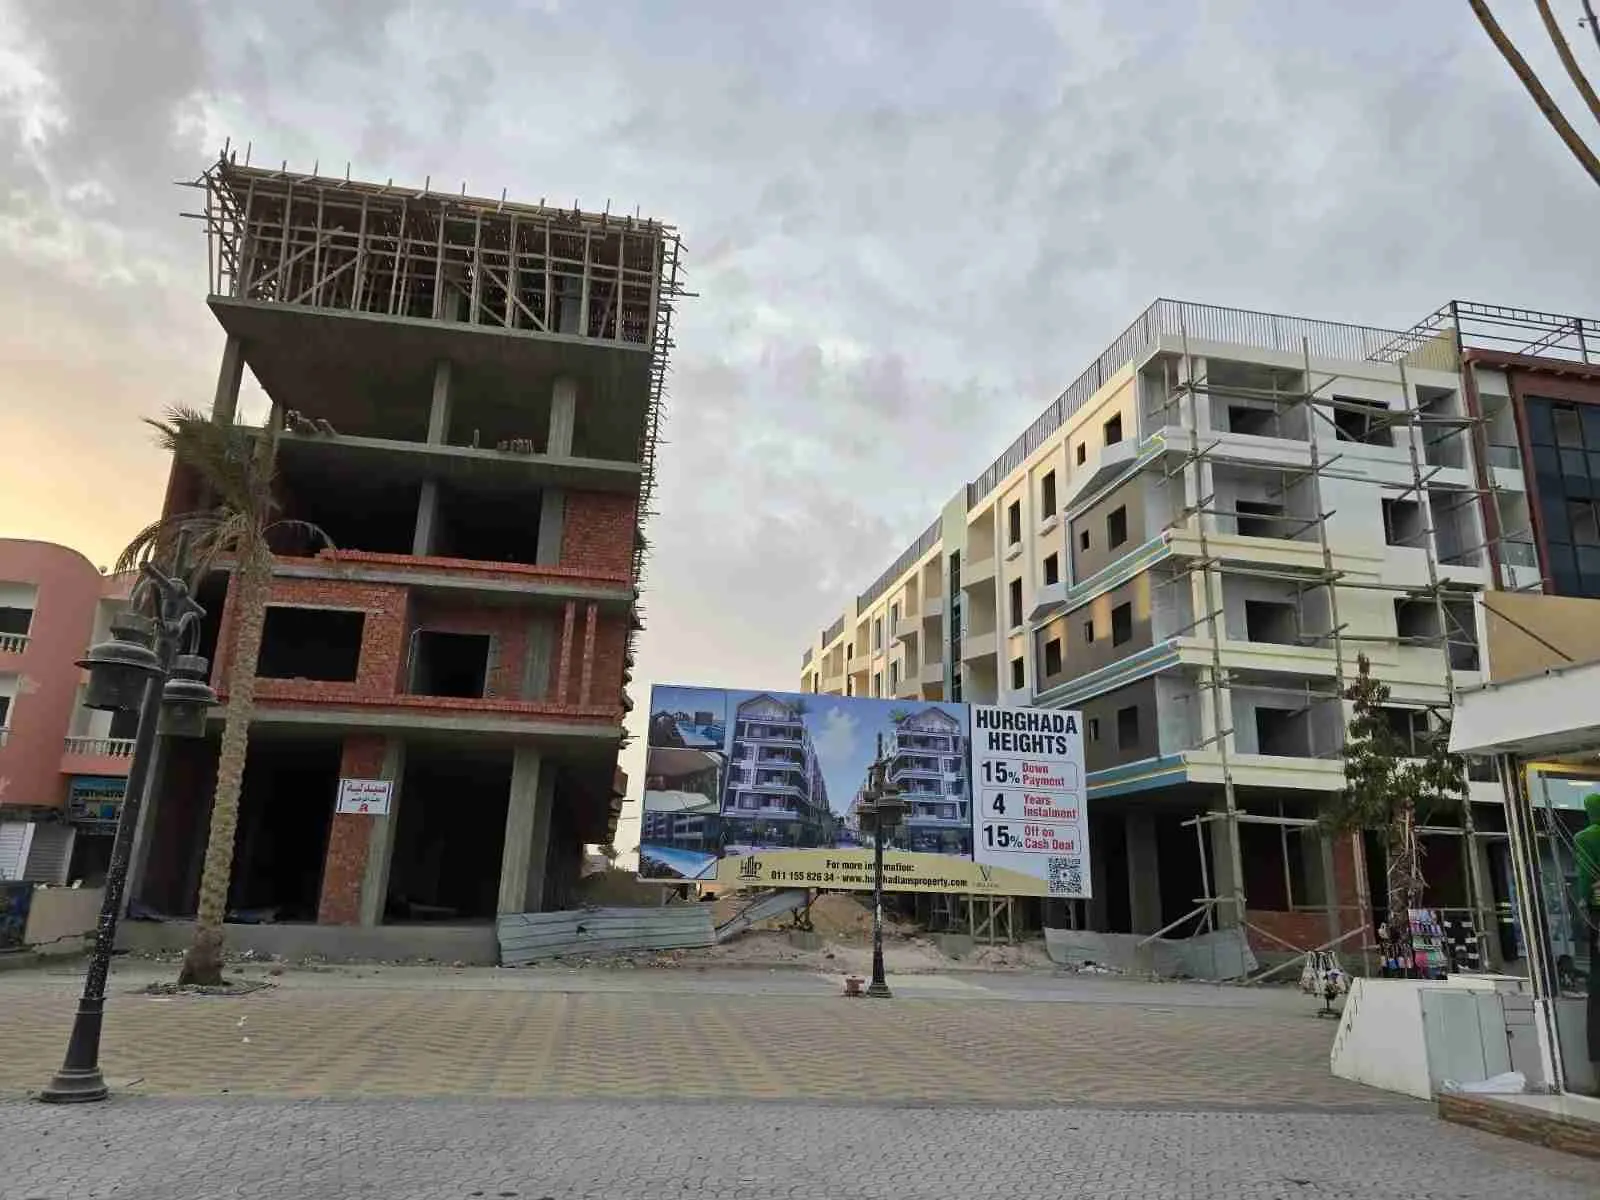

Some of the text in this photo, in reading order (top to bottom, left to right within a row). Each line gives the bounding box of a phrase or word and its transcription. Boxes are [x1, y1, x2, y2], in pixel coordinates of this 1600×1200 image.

[976, 709, 1078, 734] HURGHADA
[988, 732, 1067, 755] HEIGHTS
[982, 761, 1020, 784] 15%
[1022, 762, 1049, 774] Down
[1022, 774, 1065, 788] Payment
[992, 793, 1006, 815] 4
[1023, 794, 1051, 806] Years
[984, 825, 1023, 848] 15%
[1024, 826, 1040, 837] Off
[1024, 839, 1050, 850] Cash
[826, 860, 915, 872] For more infmation:
[771, 871, 786, 880] 011
[790, 871, 804, 881] 155
[843, 873, 967, 886] www.huhadiansproperty.com
